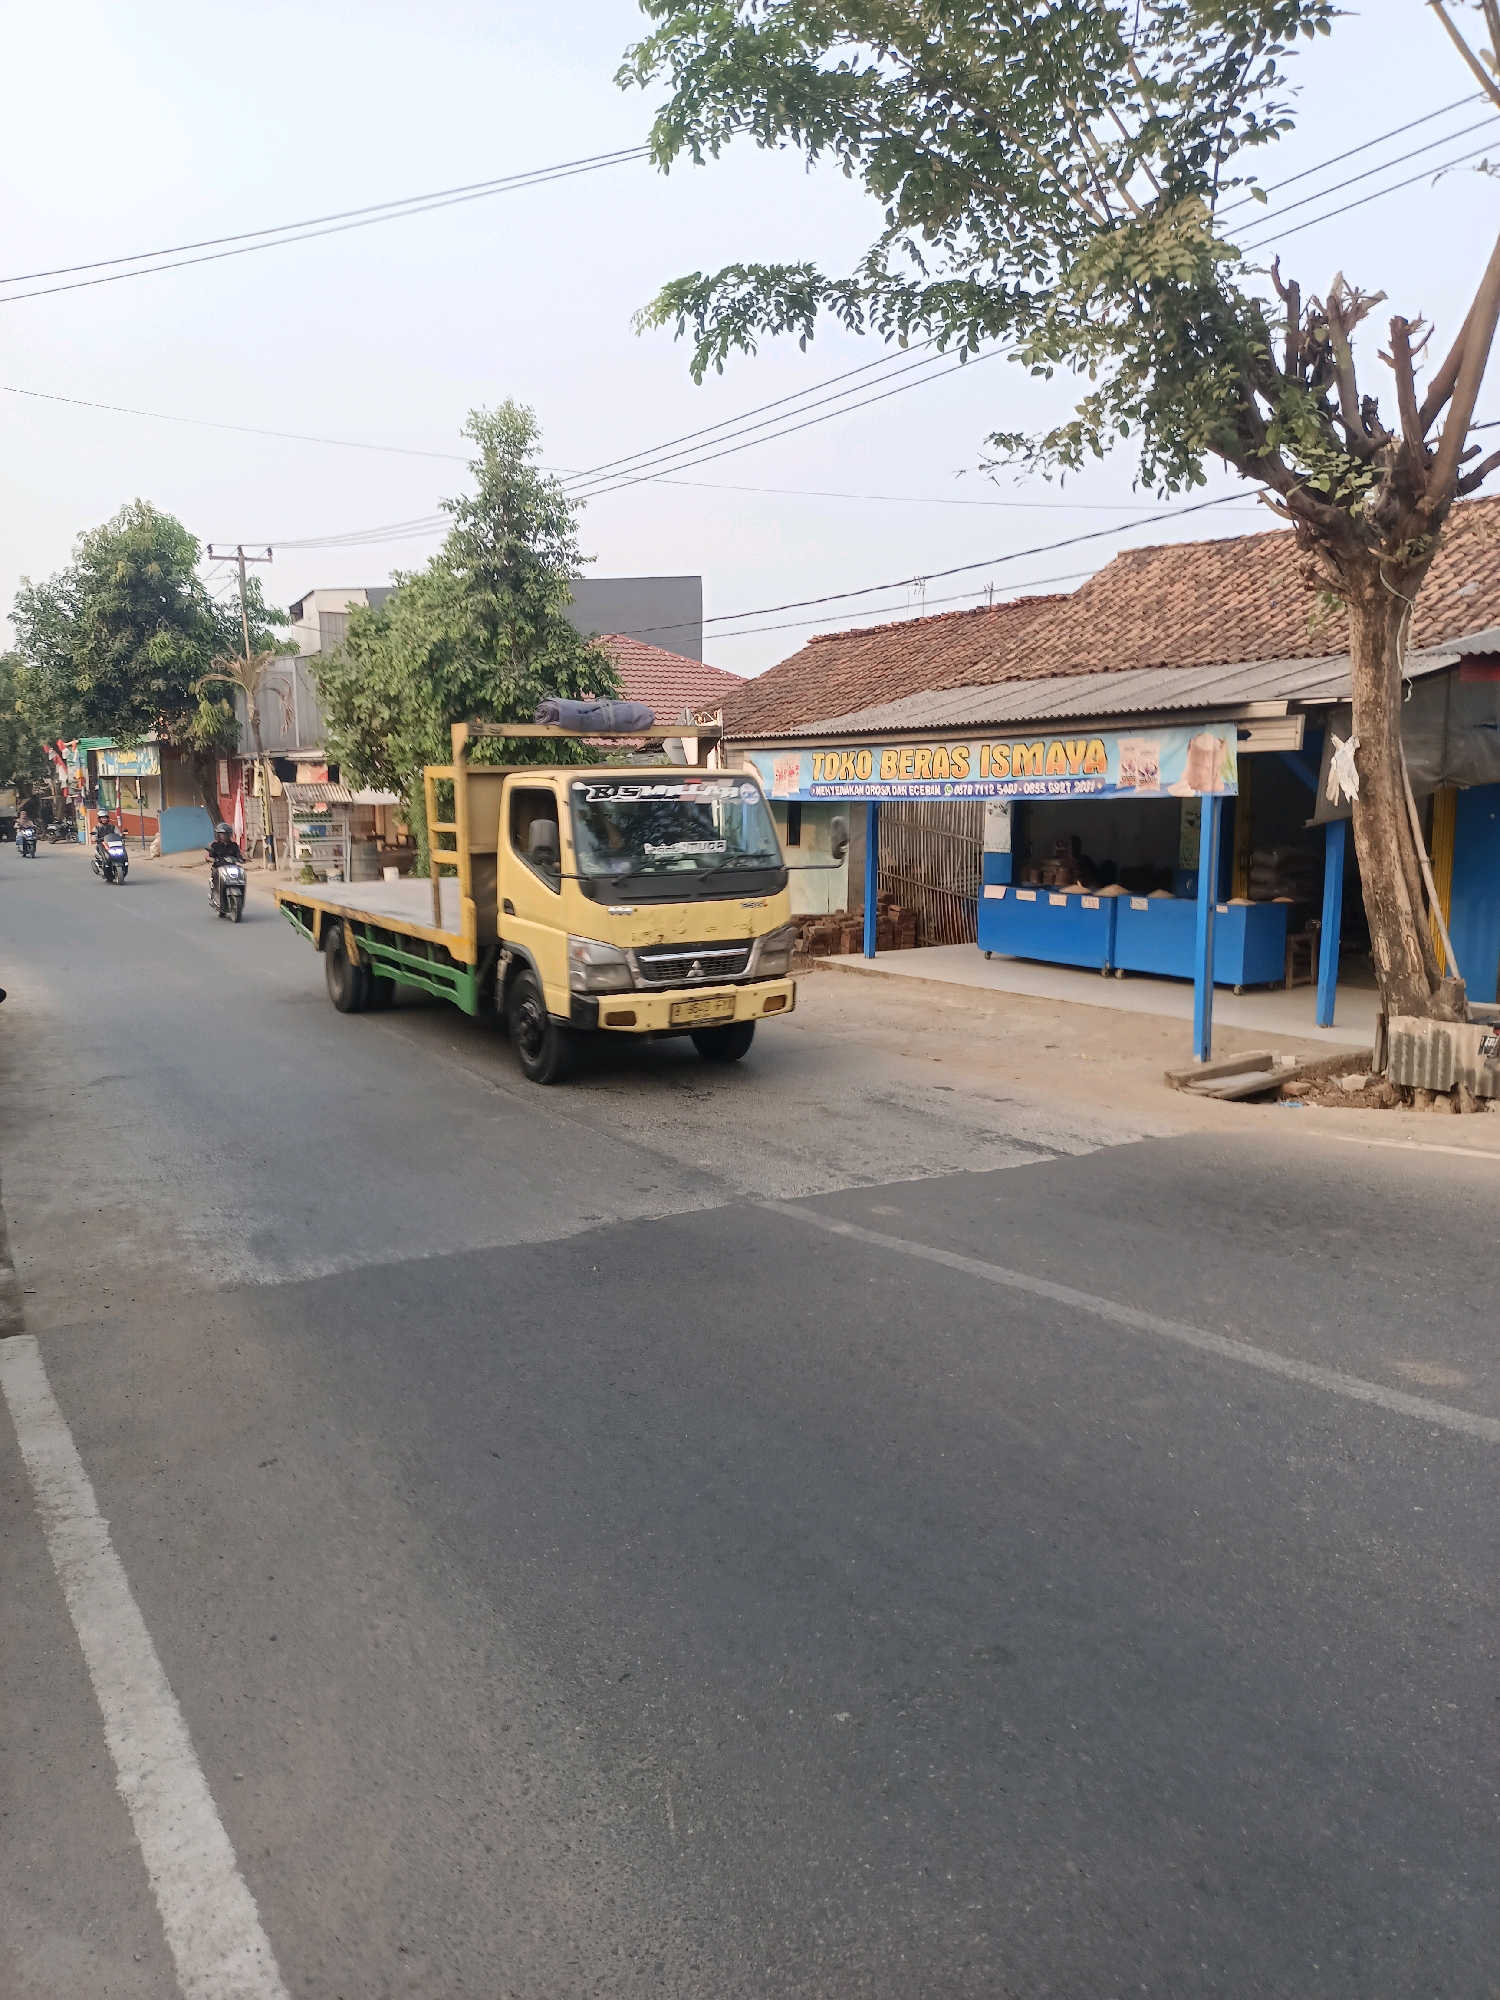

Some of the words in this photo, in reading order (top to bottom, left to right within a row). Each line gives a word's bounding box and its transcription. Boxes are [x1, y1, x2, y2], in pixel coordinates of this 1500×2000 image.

[812, 749, 873, 781] TOKO
[880, 745, 970, 780] BERAS
[980, 738, 1108, 778] ISMAYA
[892, 784, 908, 796] DAN
[908, 783, 942, 796] ECERAN
[1023, 781, 1047, 795] 0855
